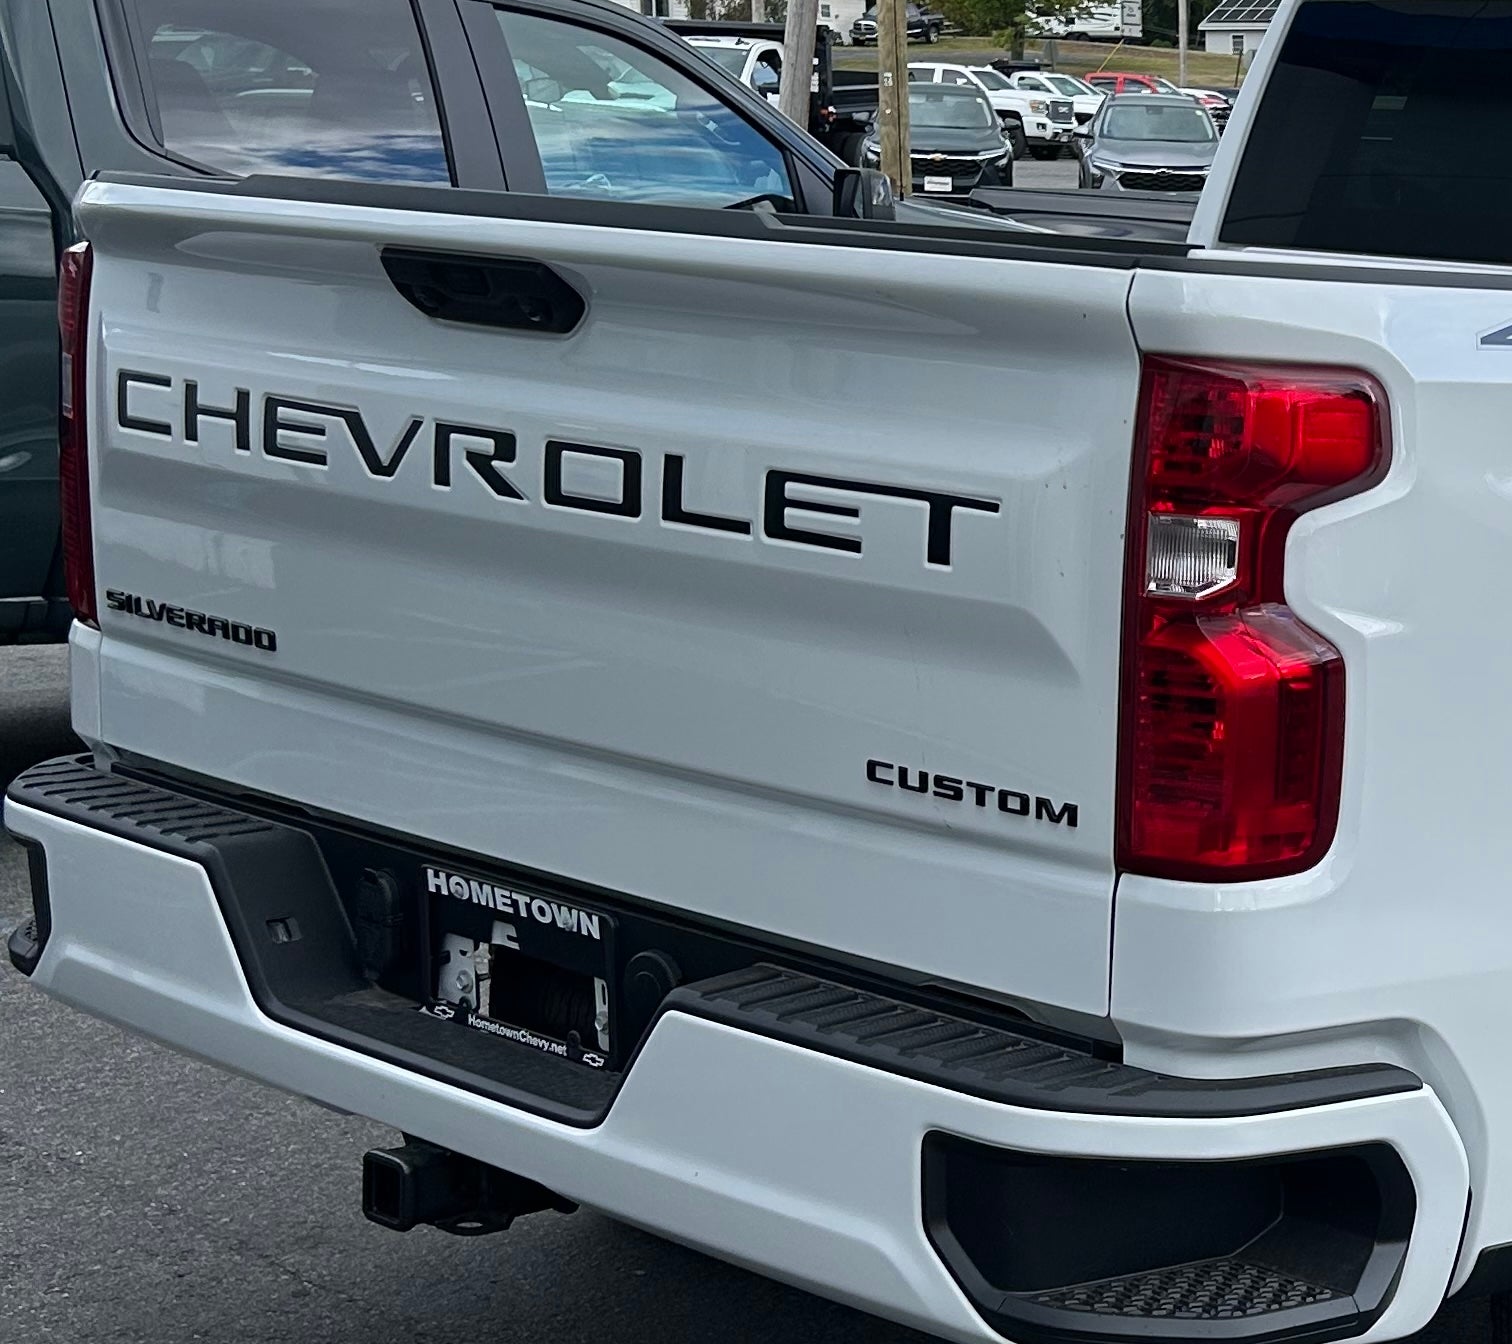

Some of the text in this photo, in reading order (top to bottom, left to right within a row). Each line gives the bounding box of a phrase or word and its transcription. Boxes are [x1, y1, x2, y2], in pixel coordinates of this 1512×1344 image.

[116, 369, 1001, 568] CHEVROLET
[105, 588, 278, 653] SILVERADO
[865, 759, 1079, 829] CUSTOM
[426, 868, 601, 940] HOMETOWN
[467, 1013, 568, 1057] HometownChevy.net
